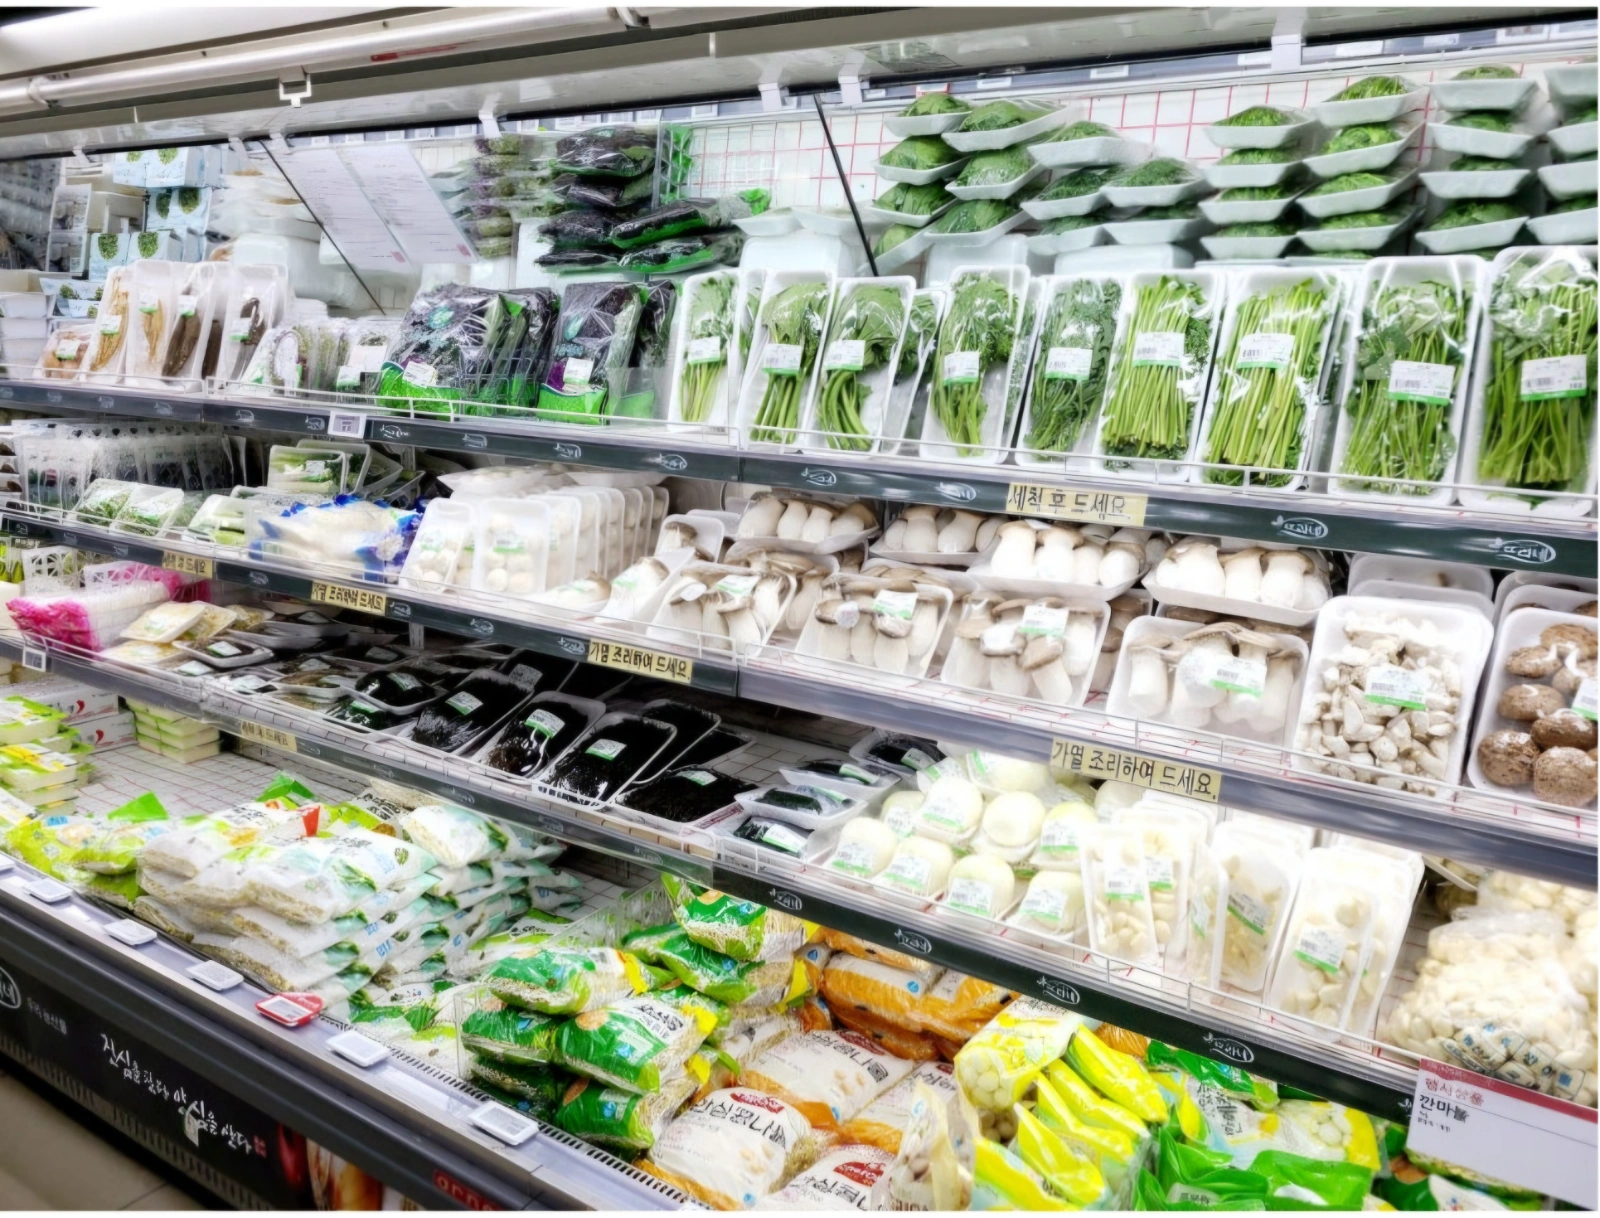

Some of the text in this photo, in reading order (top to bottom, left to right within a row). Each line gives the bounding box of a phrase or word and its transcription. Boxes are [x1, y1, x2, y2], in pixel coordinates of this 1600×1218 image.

[1008, 485, 1131, 521] 세척 후 드세요
[1052, 741, 1084, 770] 가열
[1089, 749, 1155, 787] 조리하여
